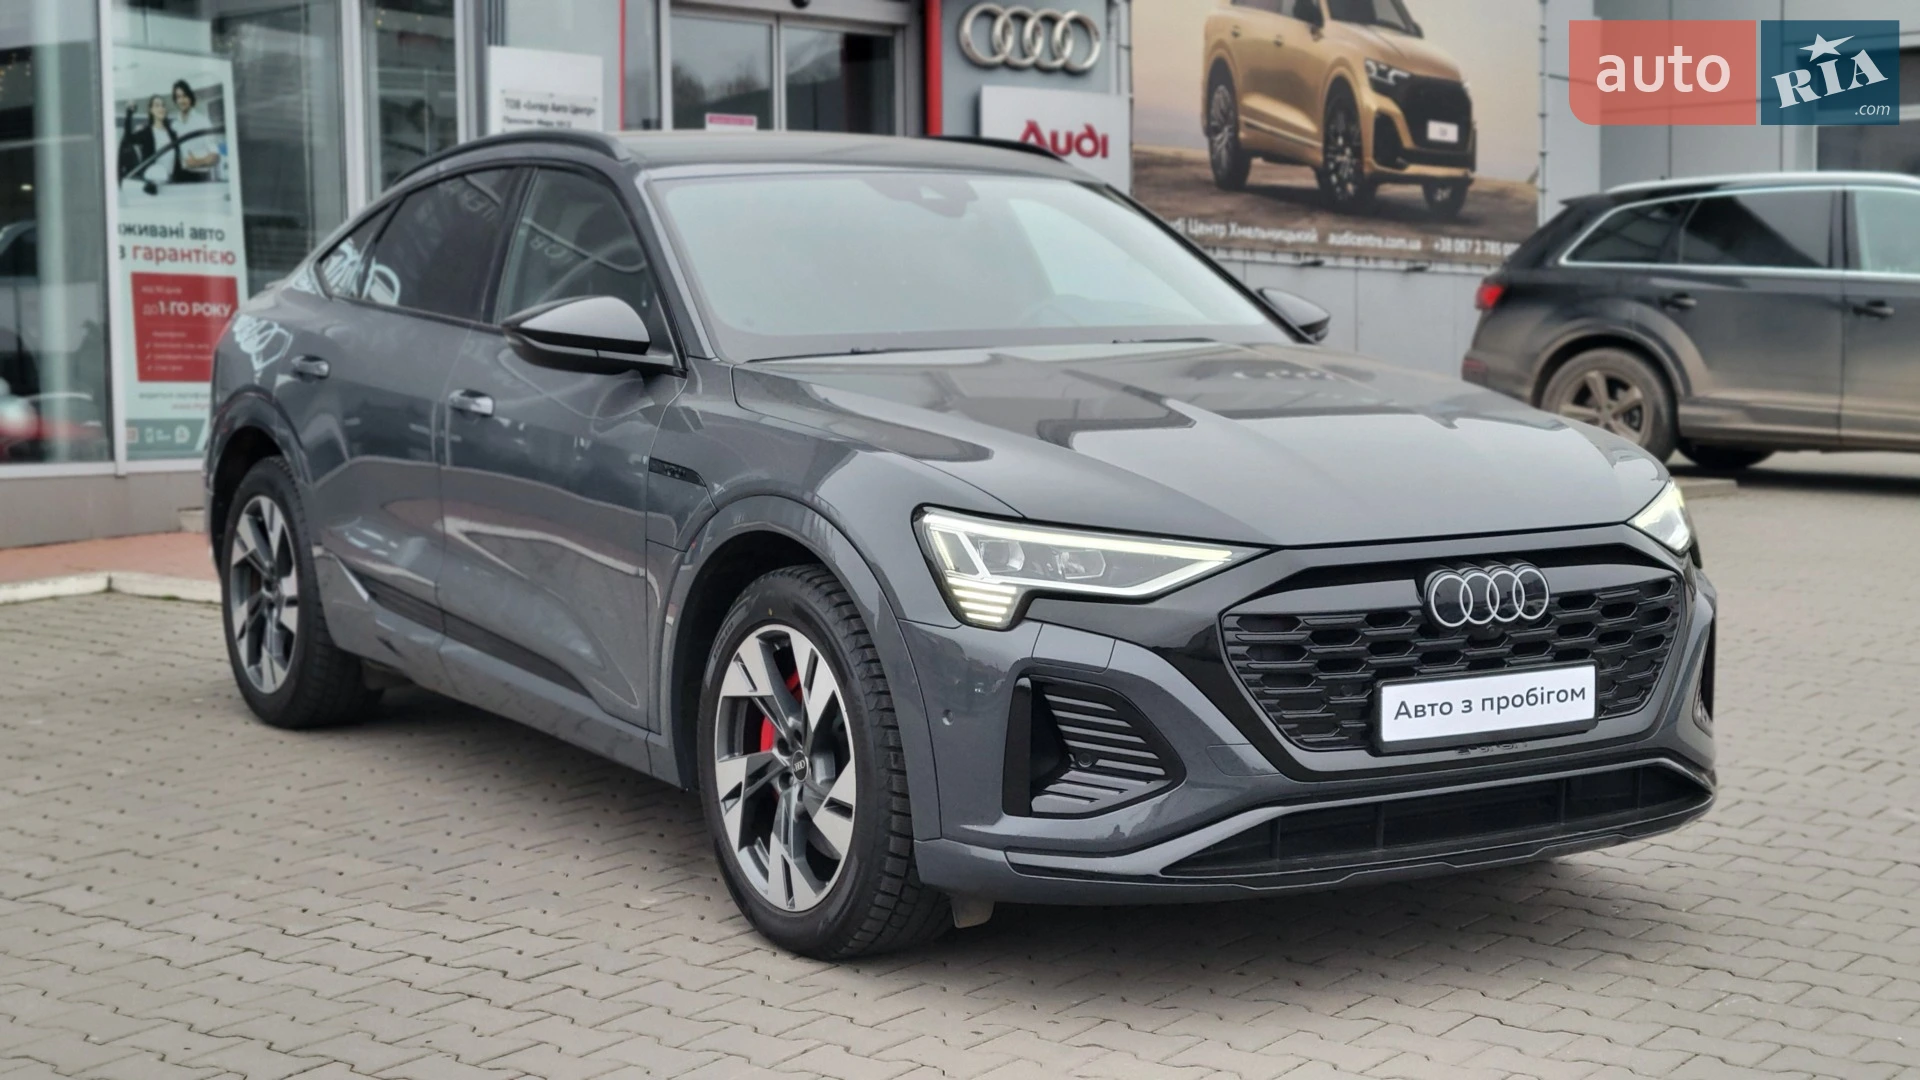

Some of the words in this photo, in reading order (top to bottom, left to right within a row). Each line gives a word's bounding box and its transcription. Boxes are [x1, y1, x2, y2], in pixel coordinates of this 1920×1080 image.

[1020, 119, 1109, 158] Audi
[118, 222, 185, 239] живані
[189, 226, 226, 241] авто
[132, 244, 237, 265] гарантією
[192, 302, 232, 318] РОКУ
[1394, 700, 1454, 720] Авто
[1461, 698, 1473, 714] з
[1481, 686, 1586, 715] пробігом
